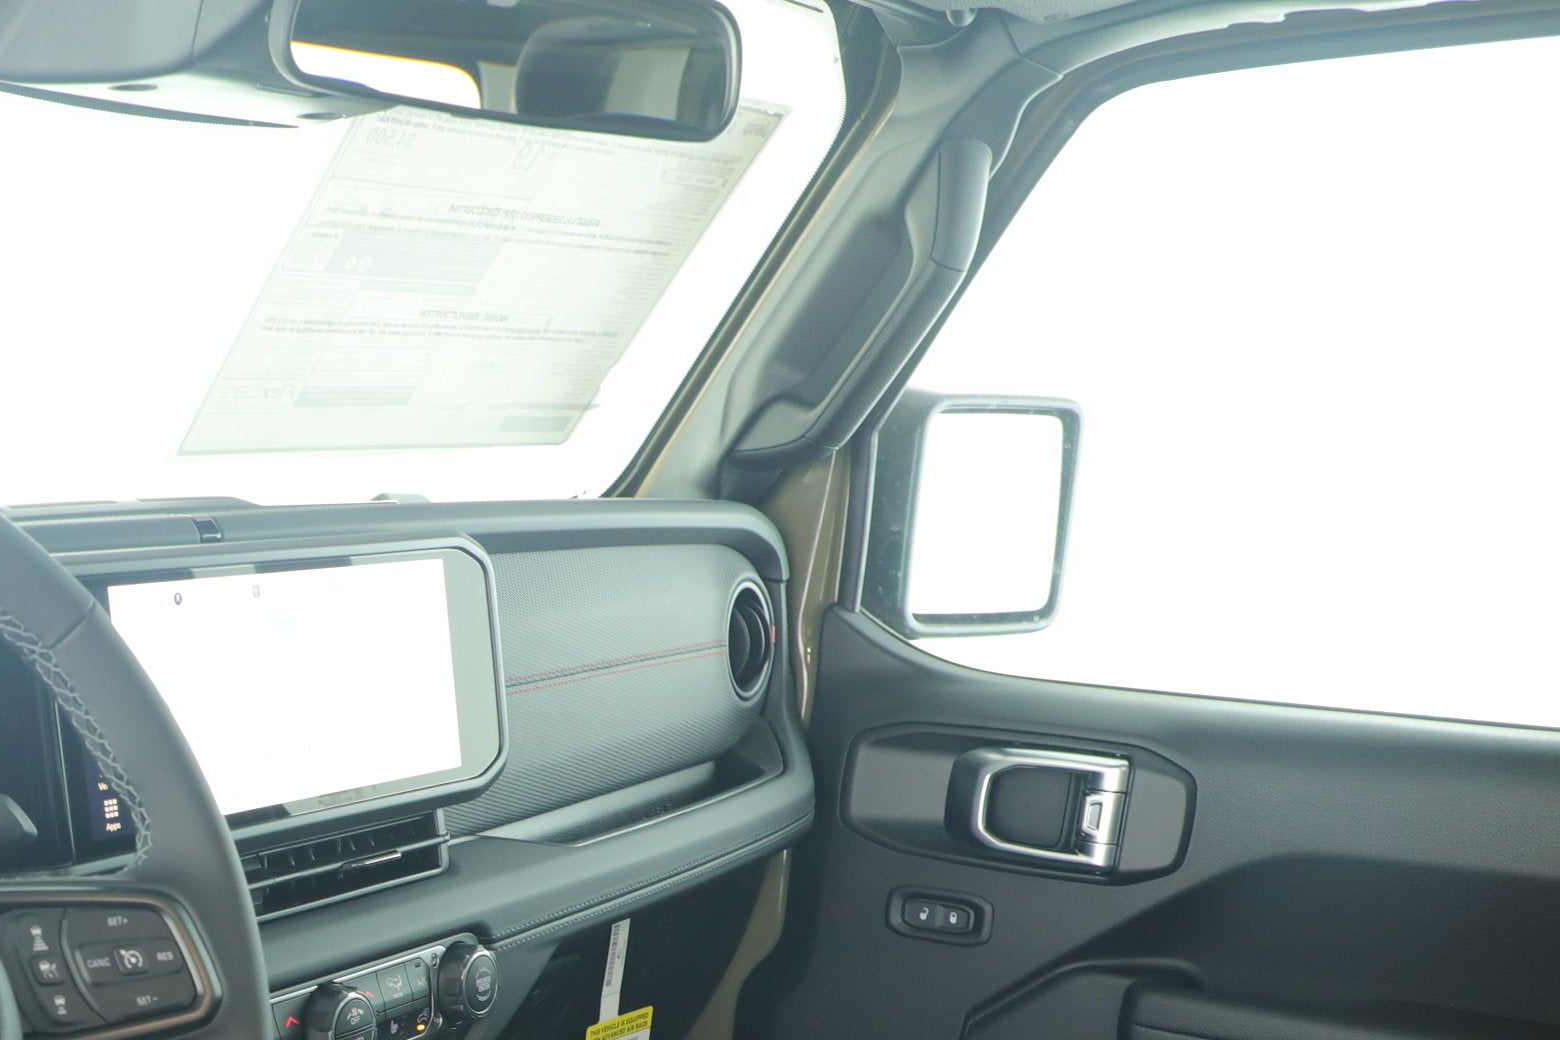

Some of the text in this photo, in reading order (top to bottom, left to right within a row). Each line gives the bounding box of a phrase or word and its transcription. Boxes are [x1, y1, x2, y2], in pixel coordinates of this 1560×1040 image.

[107, 916, 129, 927] SET+
[156, 951, 173, 962] RES
[348, 1015, 361, 1026] OFF
[601, 1022, 620, 1034] VEHICLE
[625, 1012, 649, 1025] EQUIPPED
[601, 1027, 626, 1040] ADVANCED
[626, 1024, 635, 1032] AIR
[635, 1020, 648, 1030] BAGS
